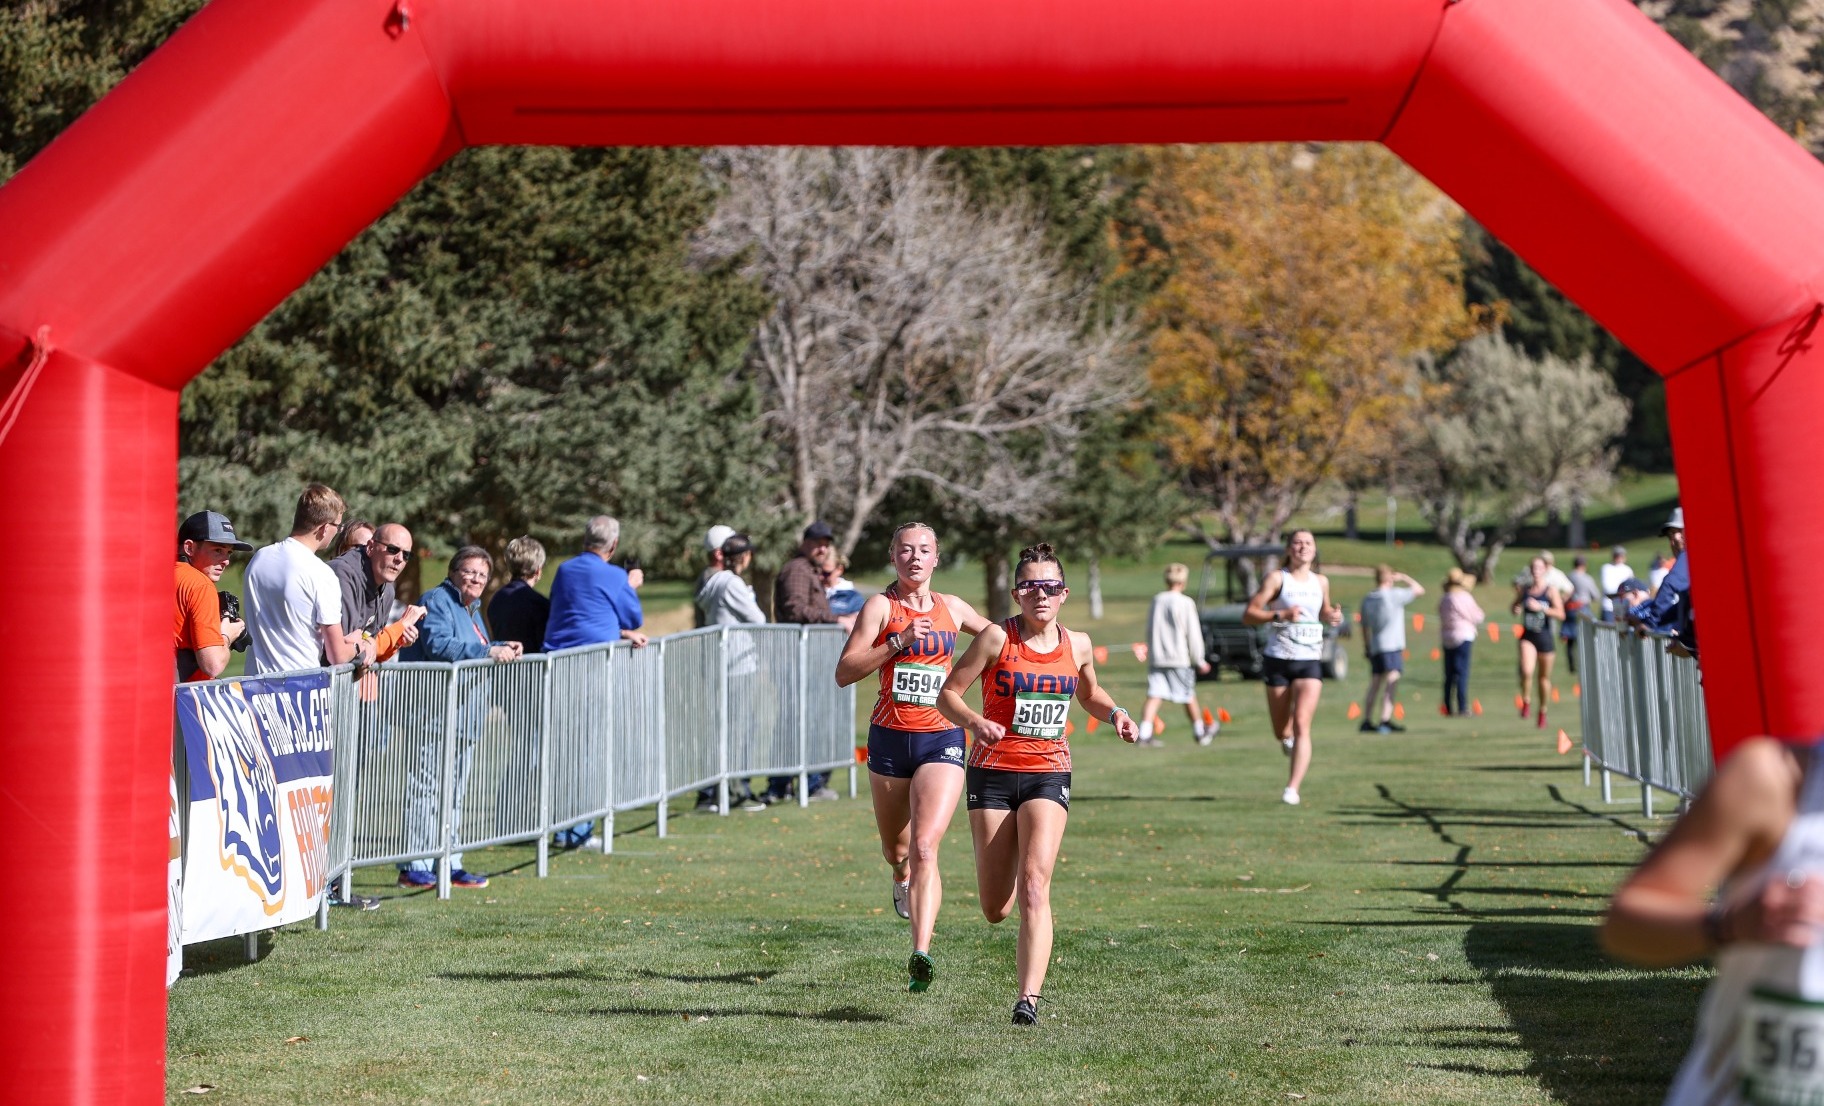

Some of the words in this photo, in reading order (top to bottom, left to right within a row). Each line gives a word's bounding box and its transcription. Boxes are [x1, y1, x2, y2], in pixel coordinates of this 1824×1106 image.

[896, 672, 942, 694] 5594
[995, 669, 1079, 699] SNOW
[897, 693, 911, 702] RUN
[911, 695, 918, 703] IT
[919, 696, 936, 704] GREE
[1018, 703, 1065, 725] 5602
[1017, 726, 1033, 735] RUN
[1033, 727, 1040, 736] IT
[1040, 728, 1059, 736] GREEN
